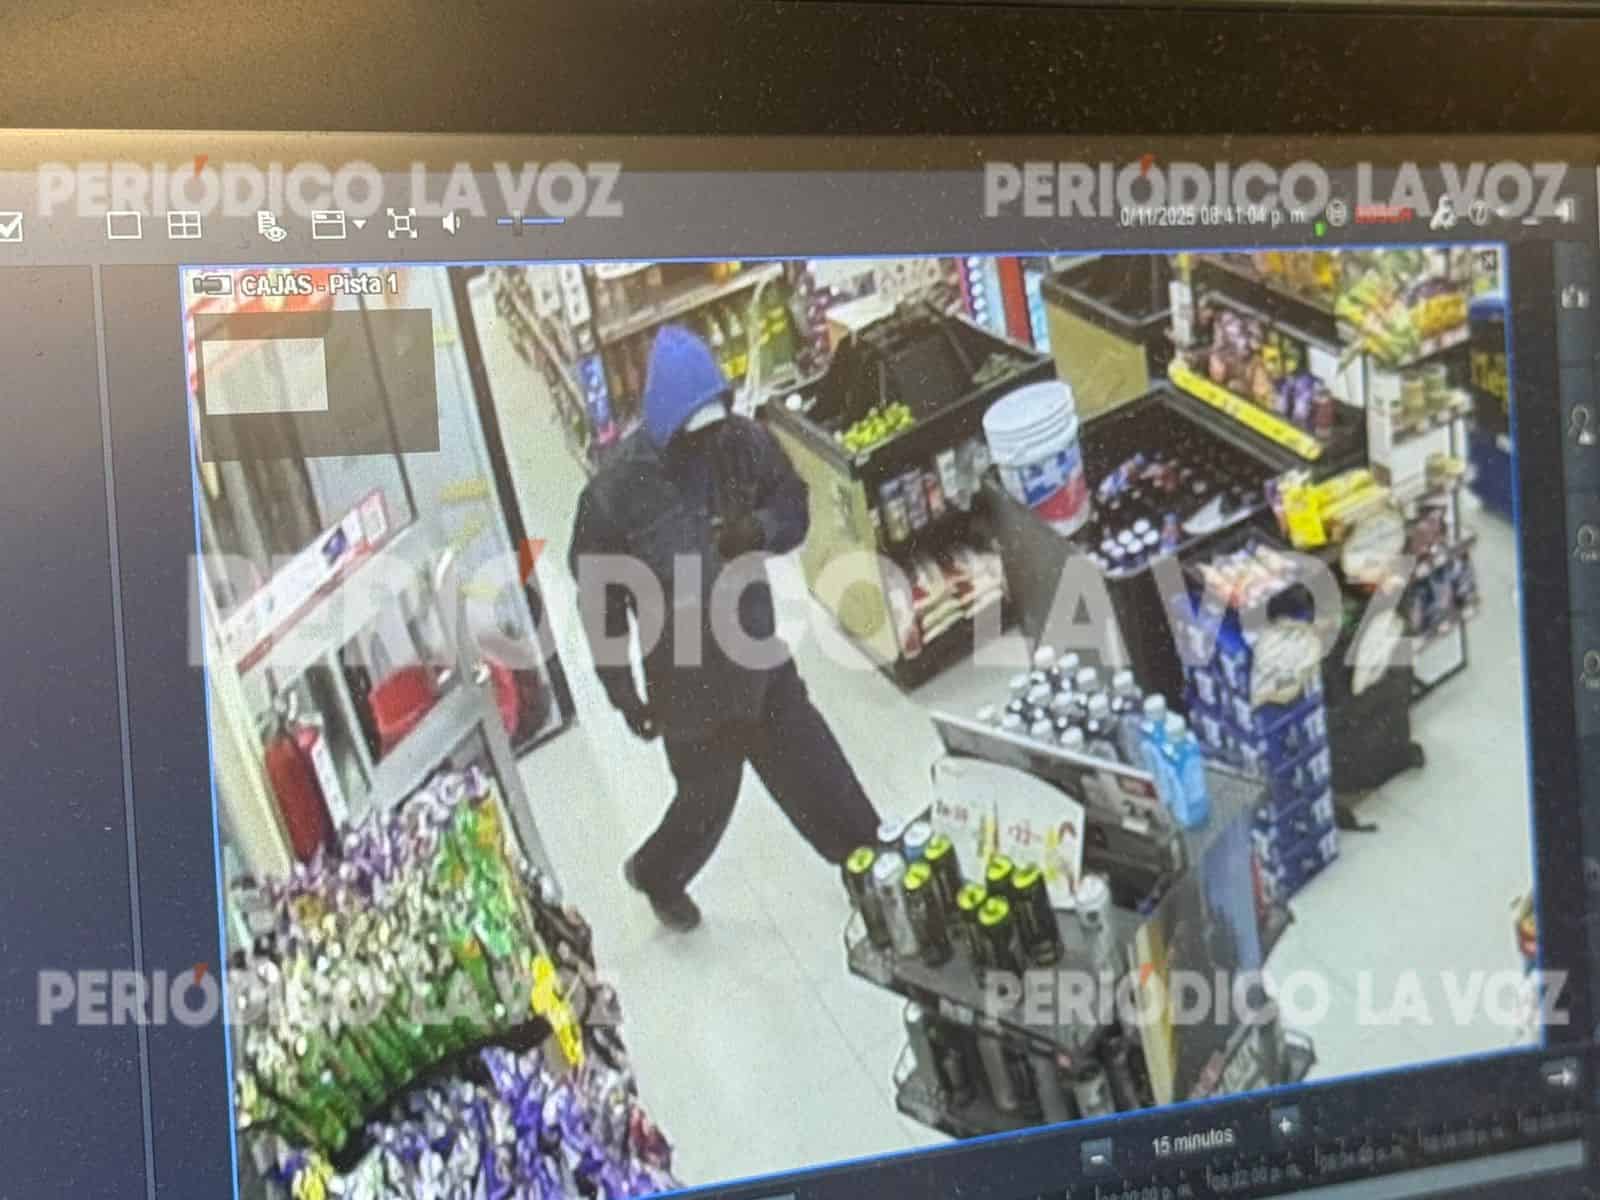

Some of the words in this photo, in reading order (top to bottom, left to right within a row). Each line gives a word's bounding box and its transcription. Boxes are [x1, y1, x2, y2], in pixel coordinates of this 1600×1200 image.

[240, 274, 313, 295] CAJAS
[329, 273, 383, 294] Pista
[387, 272, 399, 292] 1
[1152, 1135, 1172, 1155] 15
[1173, 1127, 1234, 1152] minutos
